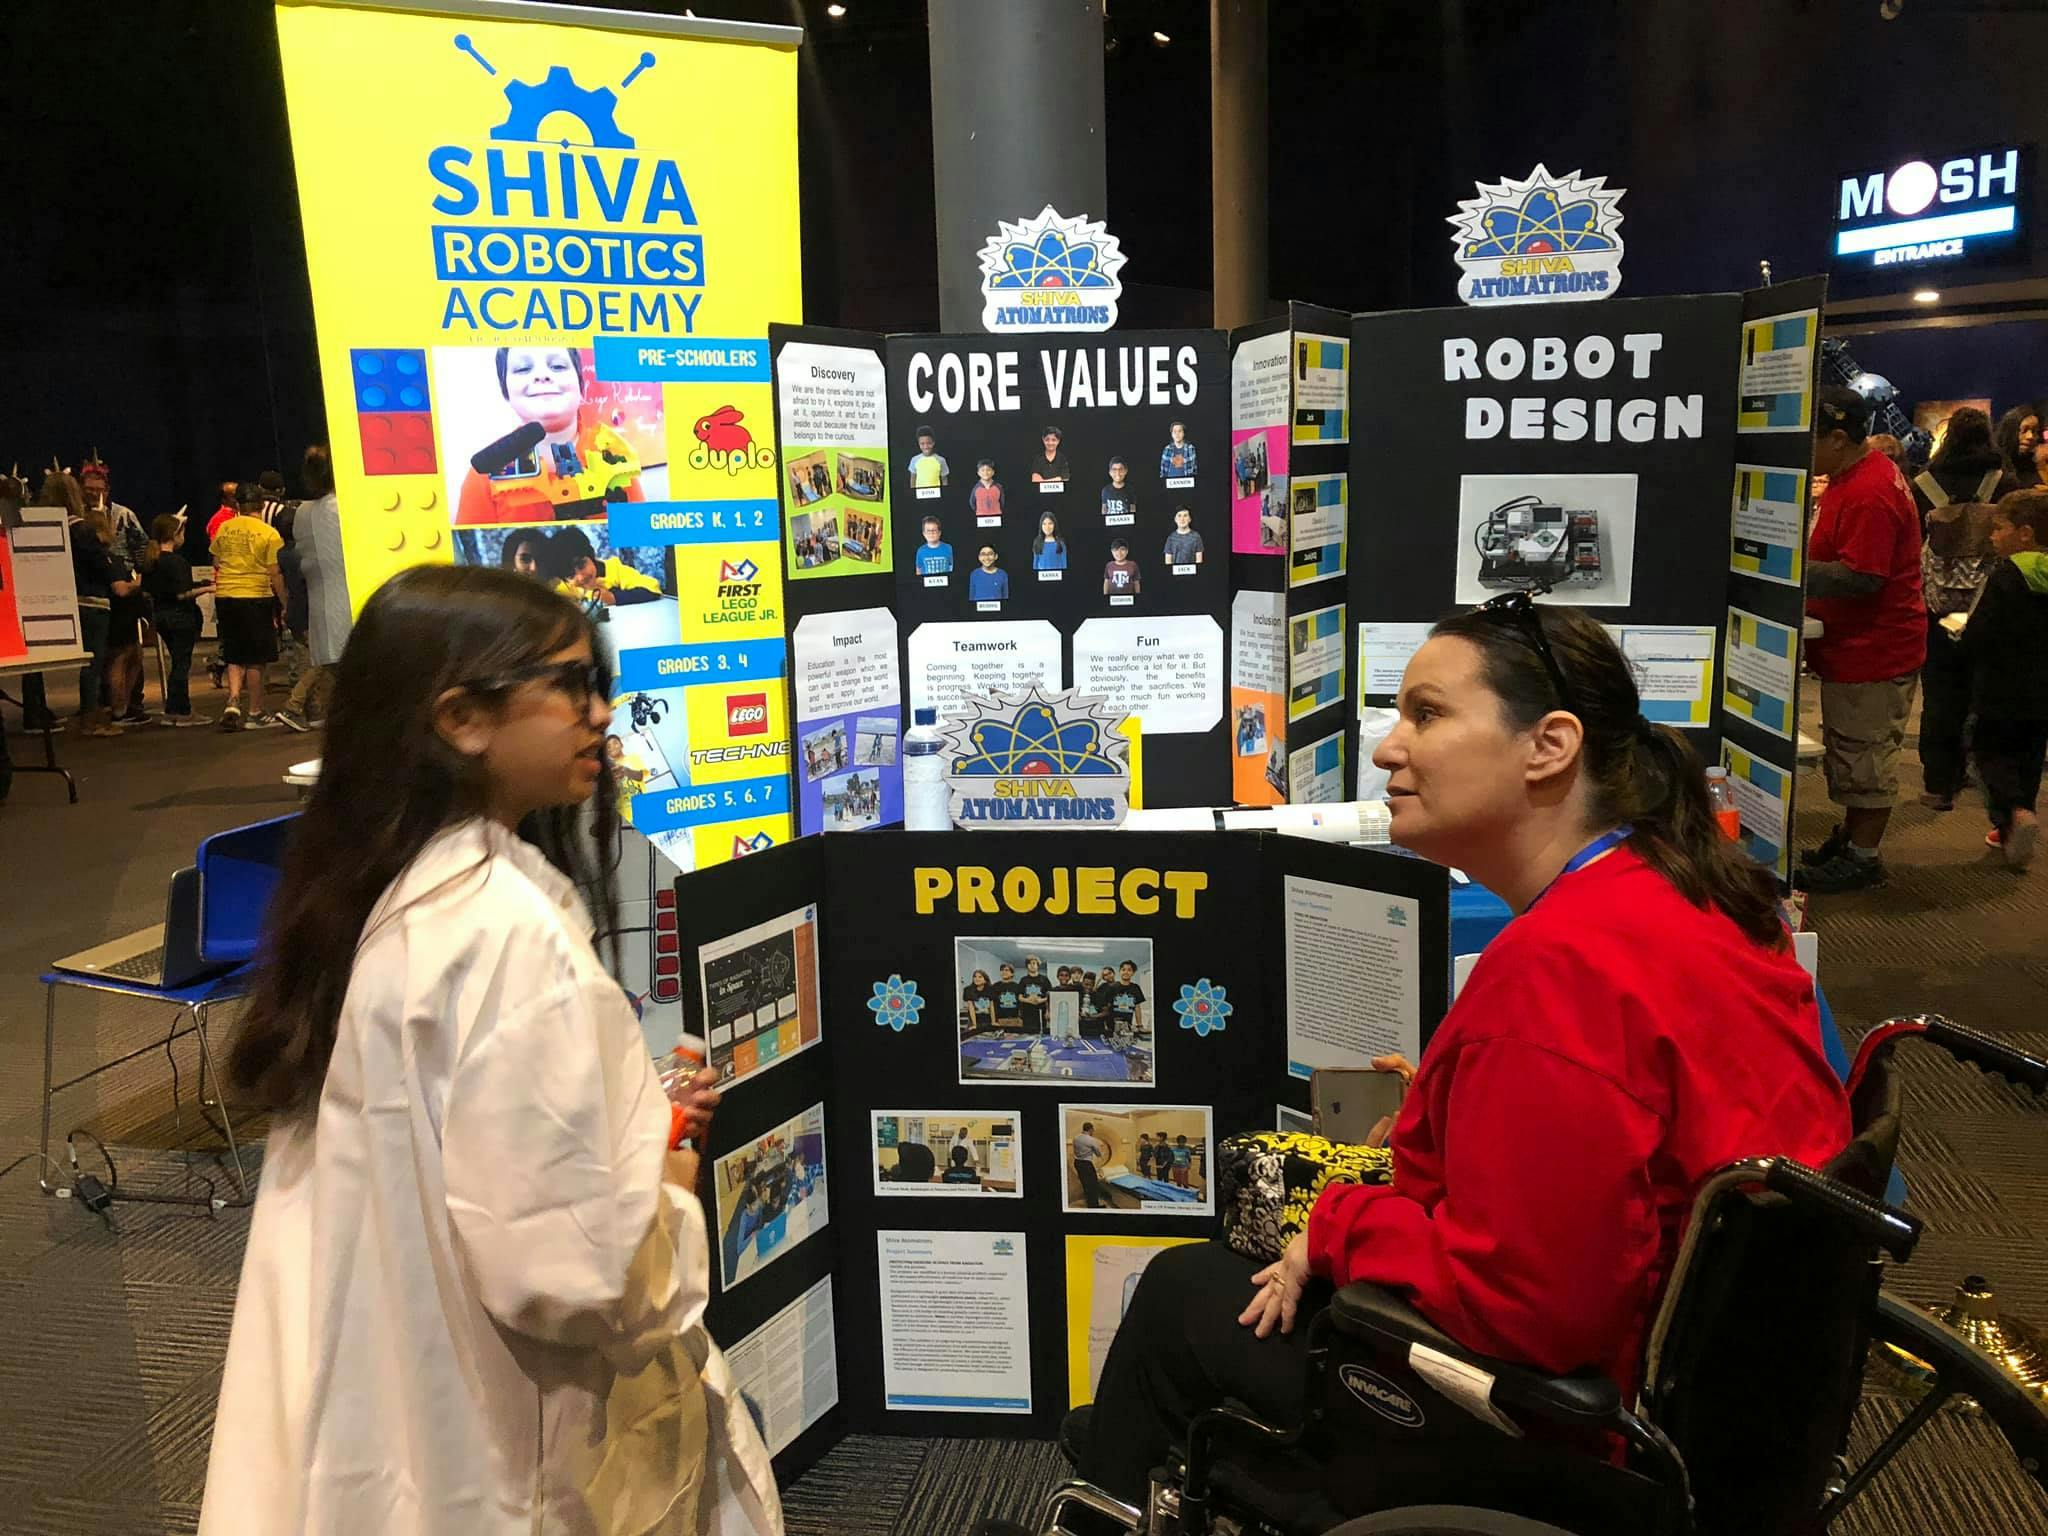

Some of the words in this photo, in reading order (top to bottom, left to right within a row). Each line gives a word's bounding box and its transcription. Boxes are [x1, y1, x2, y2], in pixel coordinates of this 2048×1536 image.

[428, 145, 698, 226] SHIVA
[1840, 150, 2018, 220] MOSH
[444, 232, 699, 280] ROBOTICS
[1873, 238, 1964, 266] ENTRANCE
[1500, 256, 1575, 276] SHIVA
[1468, 270, 1609, 299] ATOMATRONS
[1020, 291, 1081, 306] SHIVA
[441, 287, 702, 333] ACADEMY
[995, 306, 1109, 326] ATOMATRONS
[638, 349, 757, 367] PRE-SCHOOLERS
[1252, 354, 1288, 371] Innovation
[1442, 333, 1663, 382] ROBOT
[811, 366, 855, 383] Discovery
[907, 351, 1021, 414] CORE
[1040, 345, 1199, 409] VALUES
[1465, 394, 1703, 443] DESIGN
[689, 440, 775, 476] duplo
[650, 512, 704, 529] GRADES
[754, 510, 763, 526] 2
[717, 584, 761, 597] FIRST
[722, 598, 757, 609] LEGO
[703, 610, 756, 623] LEAGUE
[759, 609, 777, 621] JR.
[1253, 613, 1282, 627] Inclusion
[833, 633, 862, 648] Impact
[952, 640, 1018, 652] Teamwork
[1136, 635, 1160, 647] Fun
[657, 655, 709, 675] GRADES
[738, 653, 748, 668] 4
[1107, 654, 1129, 663] really
[1132, 654, 1153, 662] enjoy
[1156, 652, 1175, 661] what
[926, 663, 957, 672] Coming
[971, 662, 1004, 671] together
[1107, 663, 1140, 672] sacrifice
[1166, 662, 1178, 670] for
[1192, 661, 1206, 669] But
[973, 672, 1006, 681] Keeping
[1012, 671, 1044, 680] together
[1146, 673, 1158, 681] the
[1175, 671, 1206, 680] benefits
[927, 683, 934, 691] is
[977, 681, 1009, 690] Working
[1090, 684, 1126, 693] outweigh
[1192, 681, 1206, 689] We
[1130, 693, 1152, 701] much
[1158, 692, 1171, 700] fun
[1175, 691, 1206, 700] working
[730, 706, 764, 723] LEGO
[1108, 703, 1127, 711] each
[691, 741, 791, 765] TECHNIC
[993, 779, 1077, 799] SHIVA
[666, 793, 716, 814] GRADES
[764, 785, 772, 800] 7
[959, 797, 1116, 821] ATOMATRONS
[913, 866, 1208, 919] PROJECT
